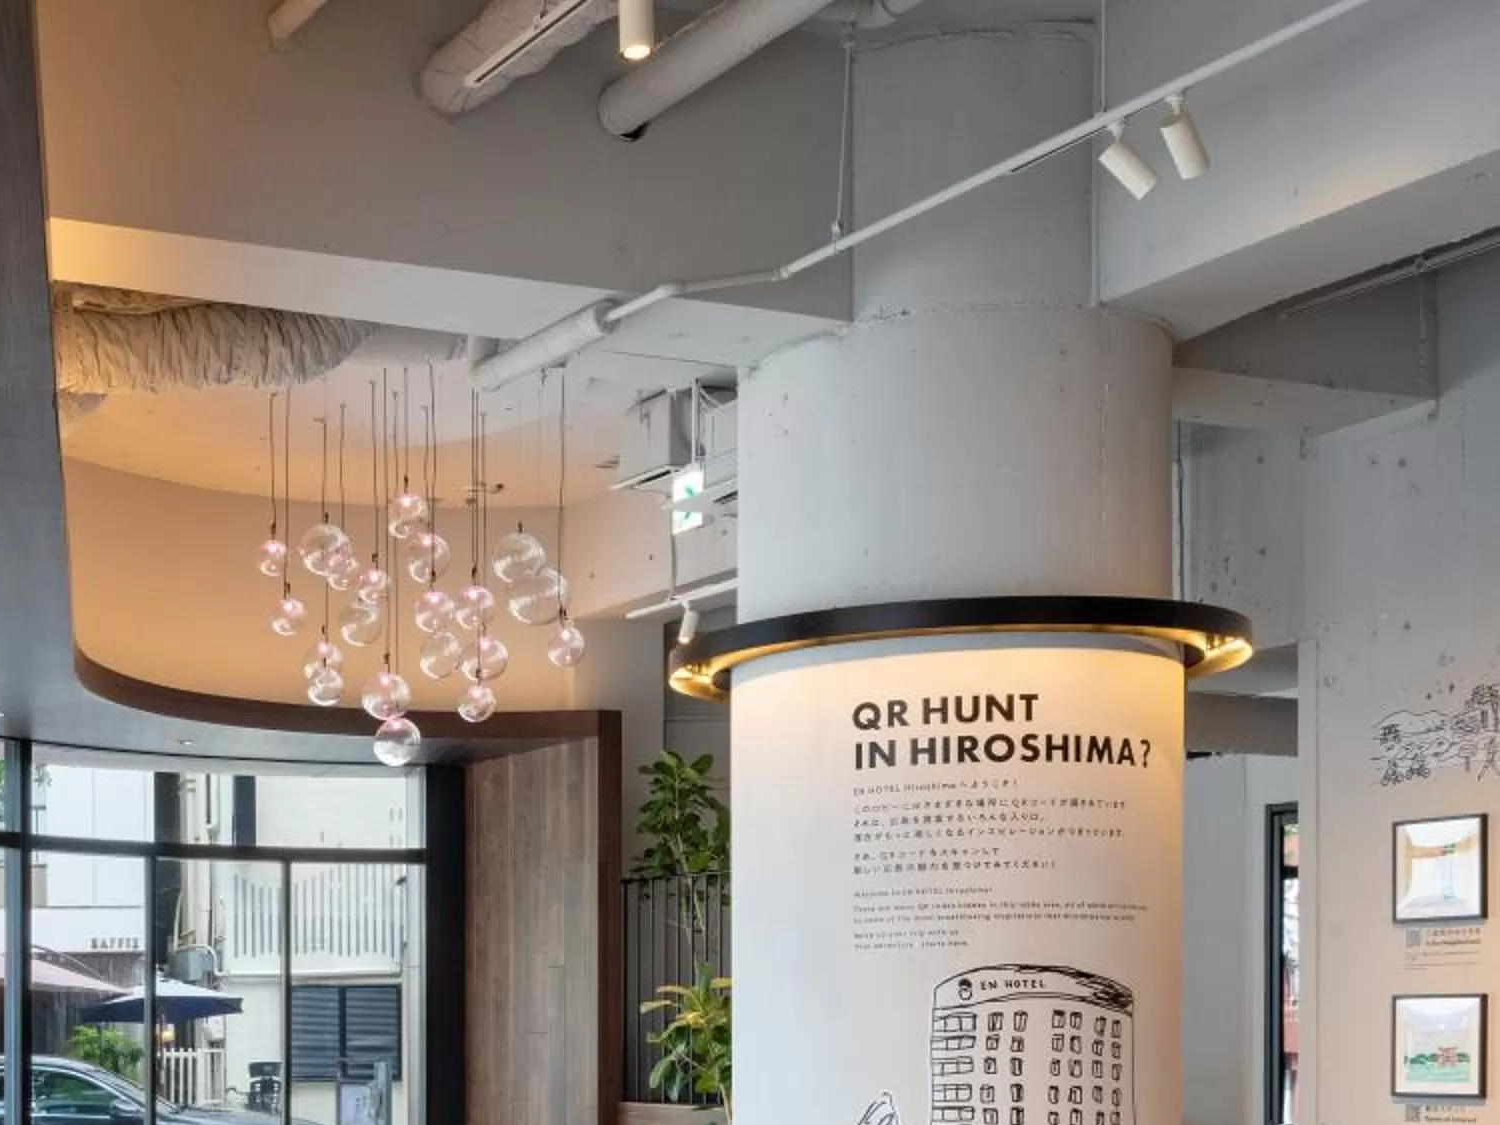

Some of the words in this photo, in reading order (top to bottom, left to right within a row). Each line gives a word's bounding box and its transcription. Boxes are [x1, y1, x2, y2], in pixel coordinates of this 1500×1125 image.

[852, 699, 909, 731] QR
[922, 693, 1039, 725] HUNT
[854, 739, 897, 770] IN
[910, 733, 1151, 768] HIROSHIMA?
[867, 783, 900, 793] HOTEL
[980, 980, 997, 991] EN
[1004, 979, 1045, 989] HOTEL
